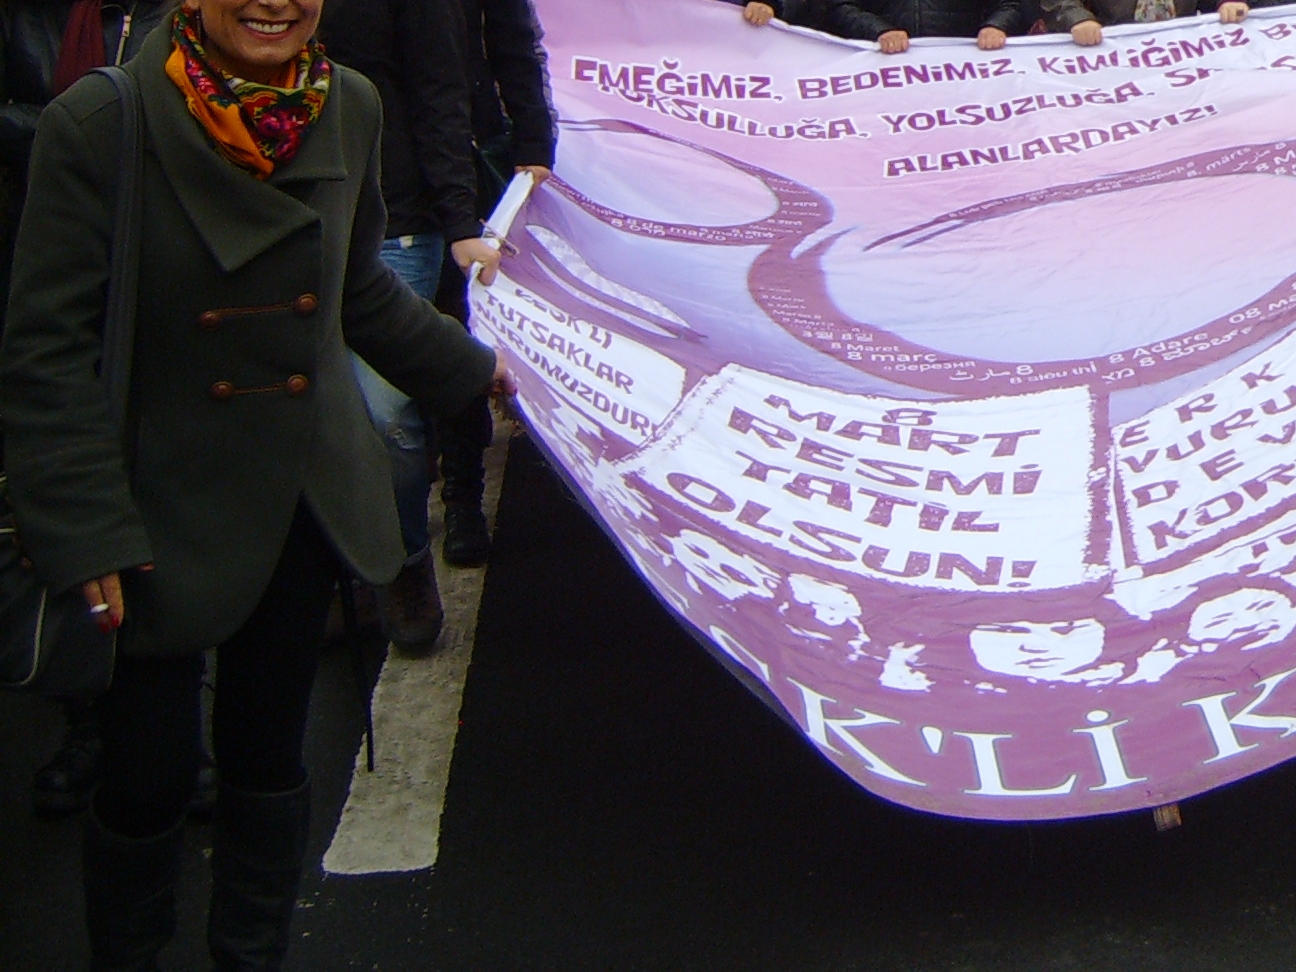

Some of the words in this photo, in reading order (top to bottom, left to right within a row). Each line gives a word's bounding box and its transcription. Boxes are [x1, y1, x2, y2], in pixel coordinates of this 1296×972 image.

[575, 59, 784, 101] EMEĞİMİZ,
[798, 58, 1027, 99] BEDENİMİZ,
[601, 86, 869, 139] OKSULLUĞA,
[881, 81, 1156, 133] YOLSUZLUĞA,
[885, 103, 1218, 177] ALANLARDAYIZ!
[475, 301, 660, 441] NURUMUZDUR!
[484, 289, 634, 394] TUTSAKLAR
[847, 351, 863, 361] 8
[1132, 332, 1209, 360] Adare
[728, 406, 1043, 496] RESMİ
[764, 393, 1041, 457] MART
[735, 450, 1001, 532] TATİL
[666, 471, 1038, 588] OLSUN!
